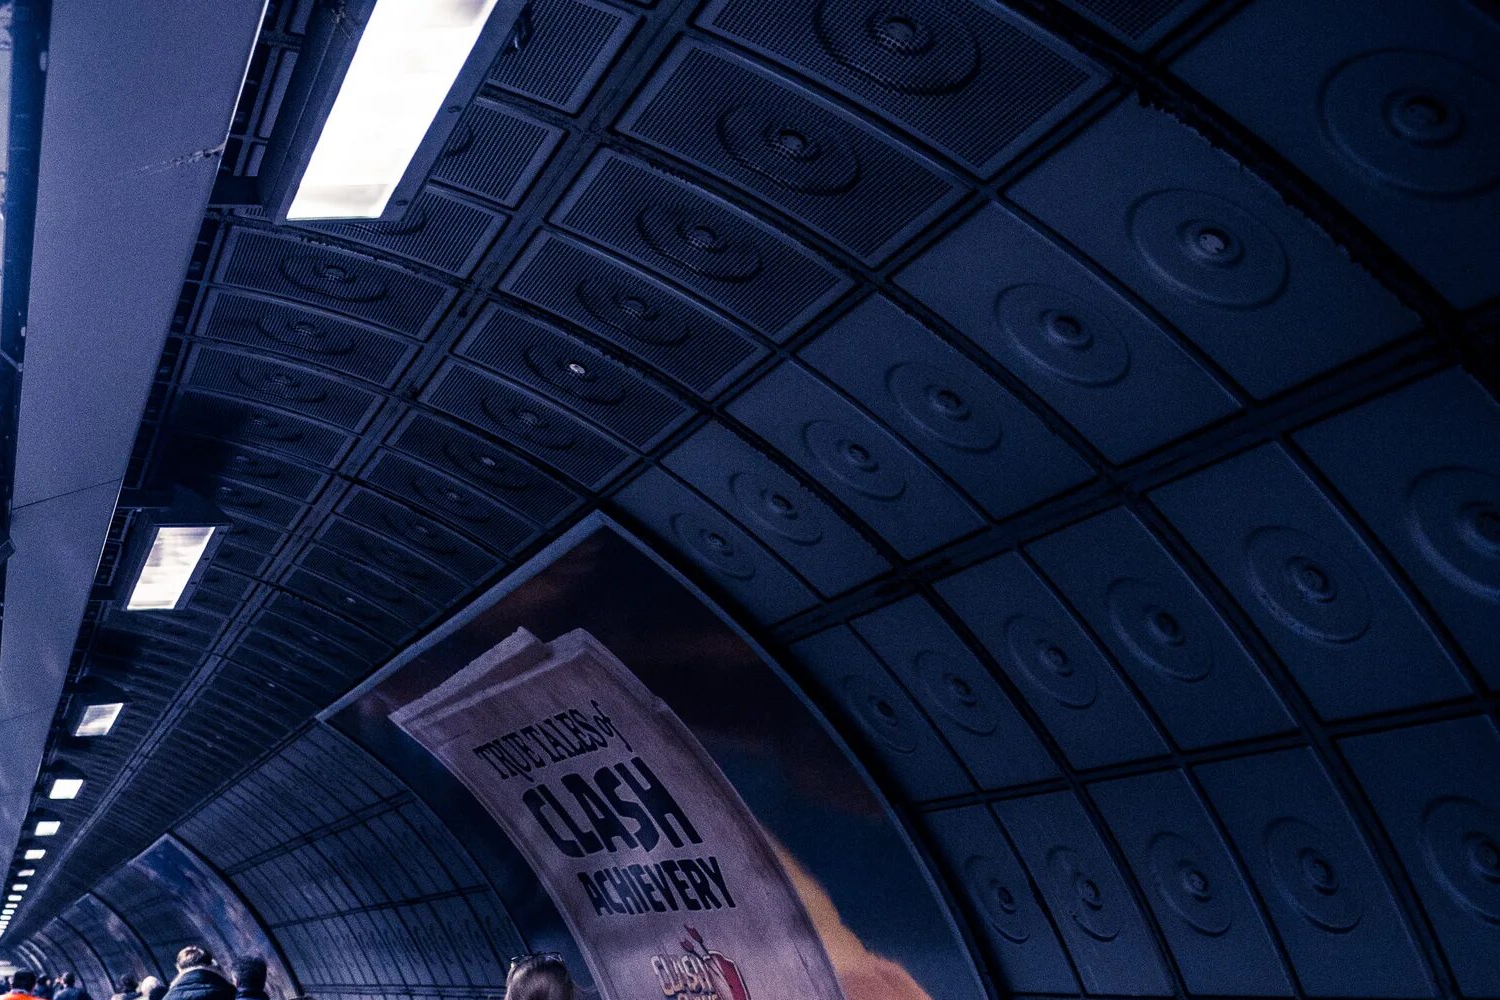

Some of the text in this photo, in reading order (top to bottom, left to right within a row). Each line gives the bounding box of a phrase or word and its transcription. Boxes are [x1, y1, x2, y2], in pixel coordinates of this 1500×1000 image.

[472, 699, 633, 782] TRUE TALES of
[522, 756, 703, 858] CLASH
[576, 856, 737, 916] ACHIEVERY
[650, 954, 716, 997] CLASH
